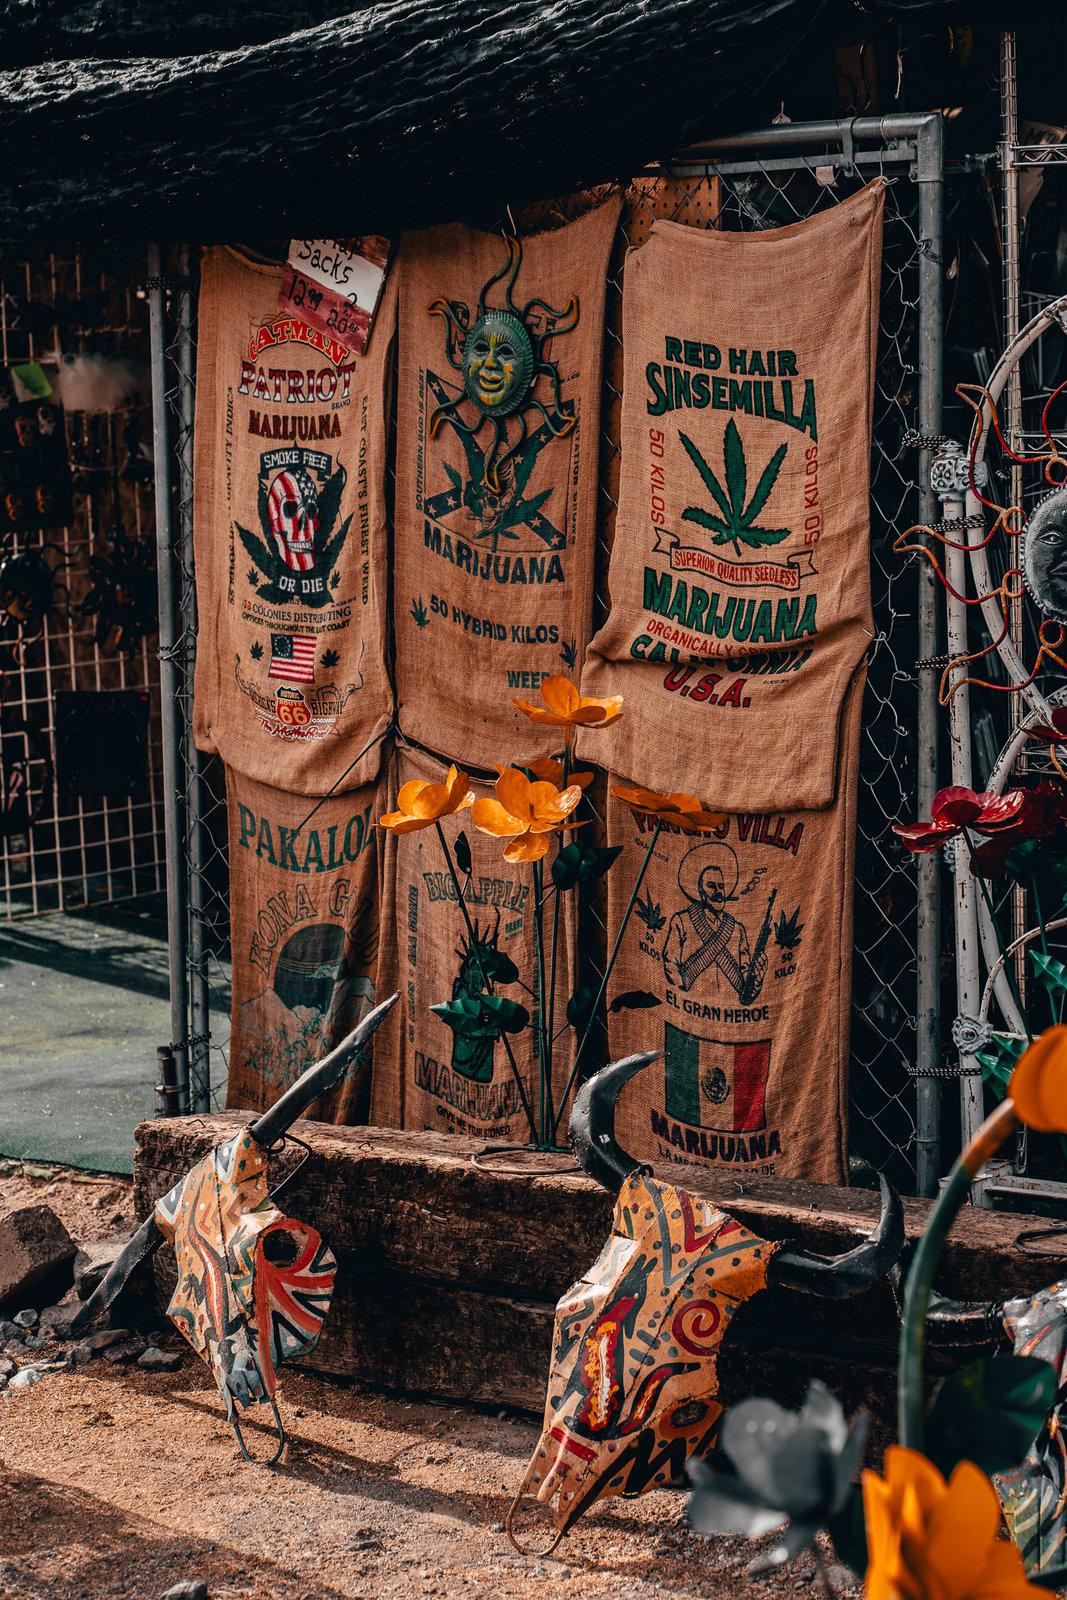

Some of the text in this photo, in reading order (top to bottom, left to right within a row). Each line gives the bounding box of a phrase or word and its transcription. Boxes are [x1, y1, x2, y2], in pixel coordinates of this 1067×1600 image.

[298, 239, 355, 284] Sacks
[248, 318, 350, 367] CATMAN
[665, 335, 799, 377] RED HAIR
[238, 360, 357, 404] PATRIOT
[645, 361, 818, 445] SINSEMILLA
[226, 386, 234, 437] INDICA
[331, 398, 352, 410] BRAND
[247, 410, 342, 442] MARIJUANA
[263, 450, 328, 470] SMOKE FREE
[358, 437, 368, 500] COAST'S
[649, 427, 665, 526] 50 KILOS
[804, 445, 821, 546] 50 KILOS
[359, 502, 369, 556] FINEST
[423, 519, 566, 585] MARIJUANA
[674, 550, 798, 587] SUPERIOR QUALITY SEEDLESS
[278, 576, 324, 594] OR DIE
[643, 566, 818, 644] MARIJUANA
[252, 603, 292, 622] COLONIES
[293, 606, 352, 624] DISTRIBUTING
[326, 619, 351, 632] COAST
[429, 593, 560, 644] 50 HYBRID KILOS
[645, 619, 734, 657] ORGANICALLY
[664, 662, 752, 709] U.S.A.
[279, 706, 308, 726] 66
[736, 813, 805, 856] VILLA
[422, 871, 460, 902] BIG
[249, 883, 318, 979] KONA
[638, 940, 661, 961] KILOS
[773, 963, 797, 980] KILOS
[665, 988, 770, 1024] EL GRAN HEROE
[483, 1124, 511, 1138] STONED
[650, 1108, 782, 1162] MARIJUANA
